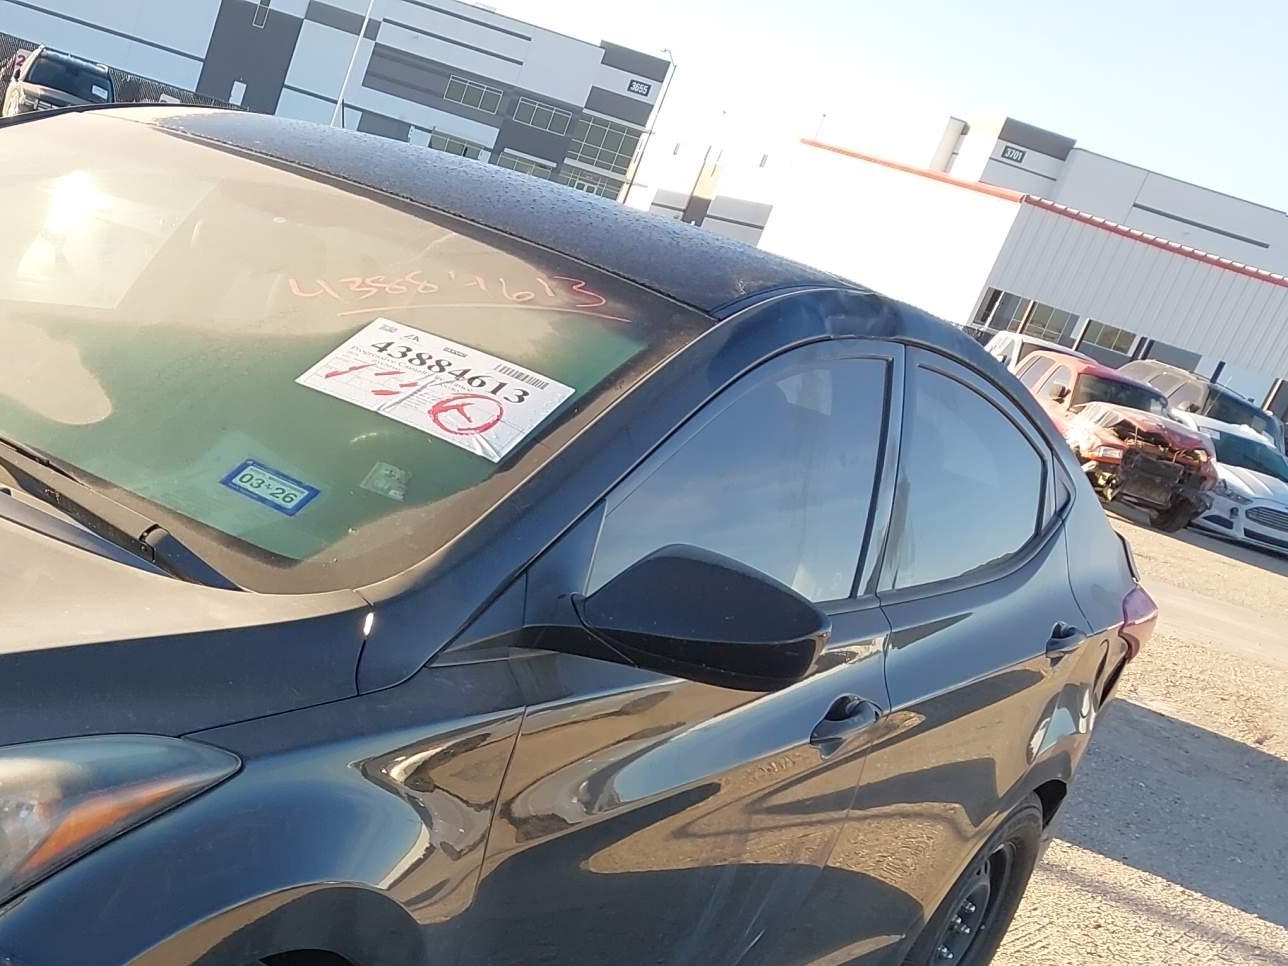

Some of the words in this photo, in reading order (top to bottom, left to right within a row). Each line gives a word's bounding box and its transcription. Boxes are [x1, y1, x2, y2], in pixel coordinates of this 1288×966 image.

[630, 82, 649, 94] 3655
[1004, 148, 1022, 160] 3701
[370, 341, 531, 404] 43884613
